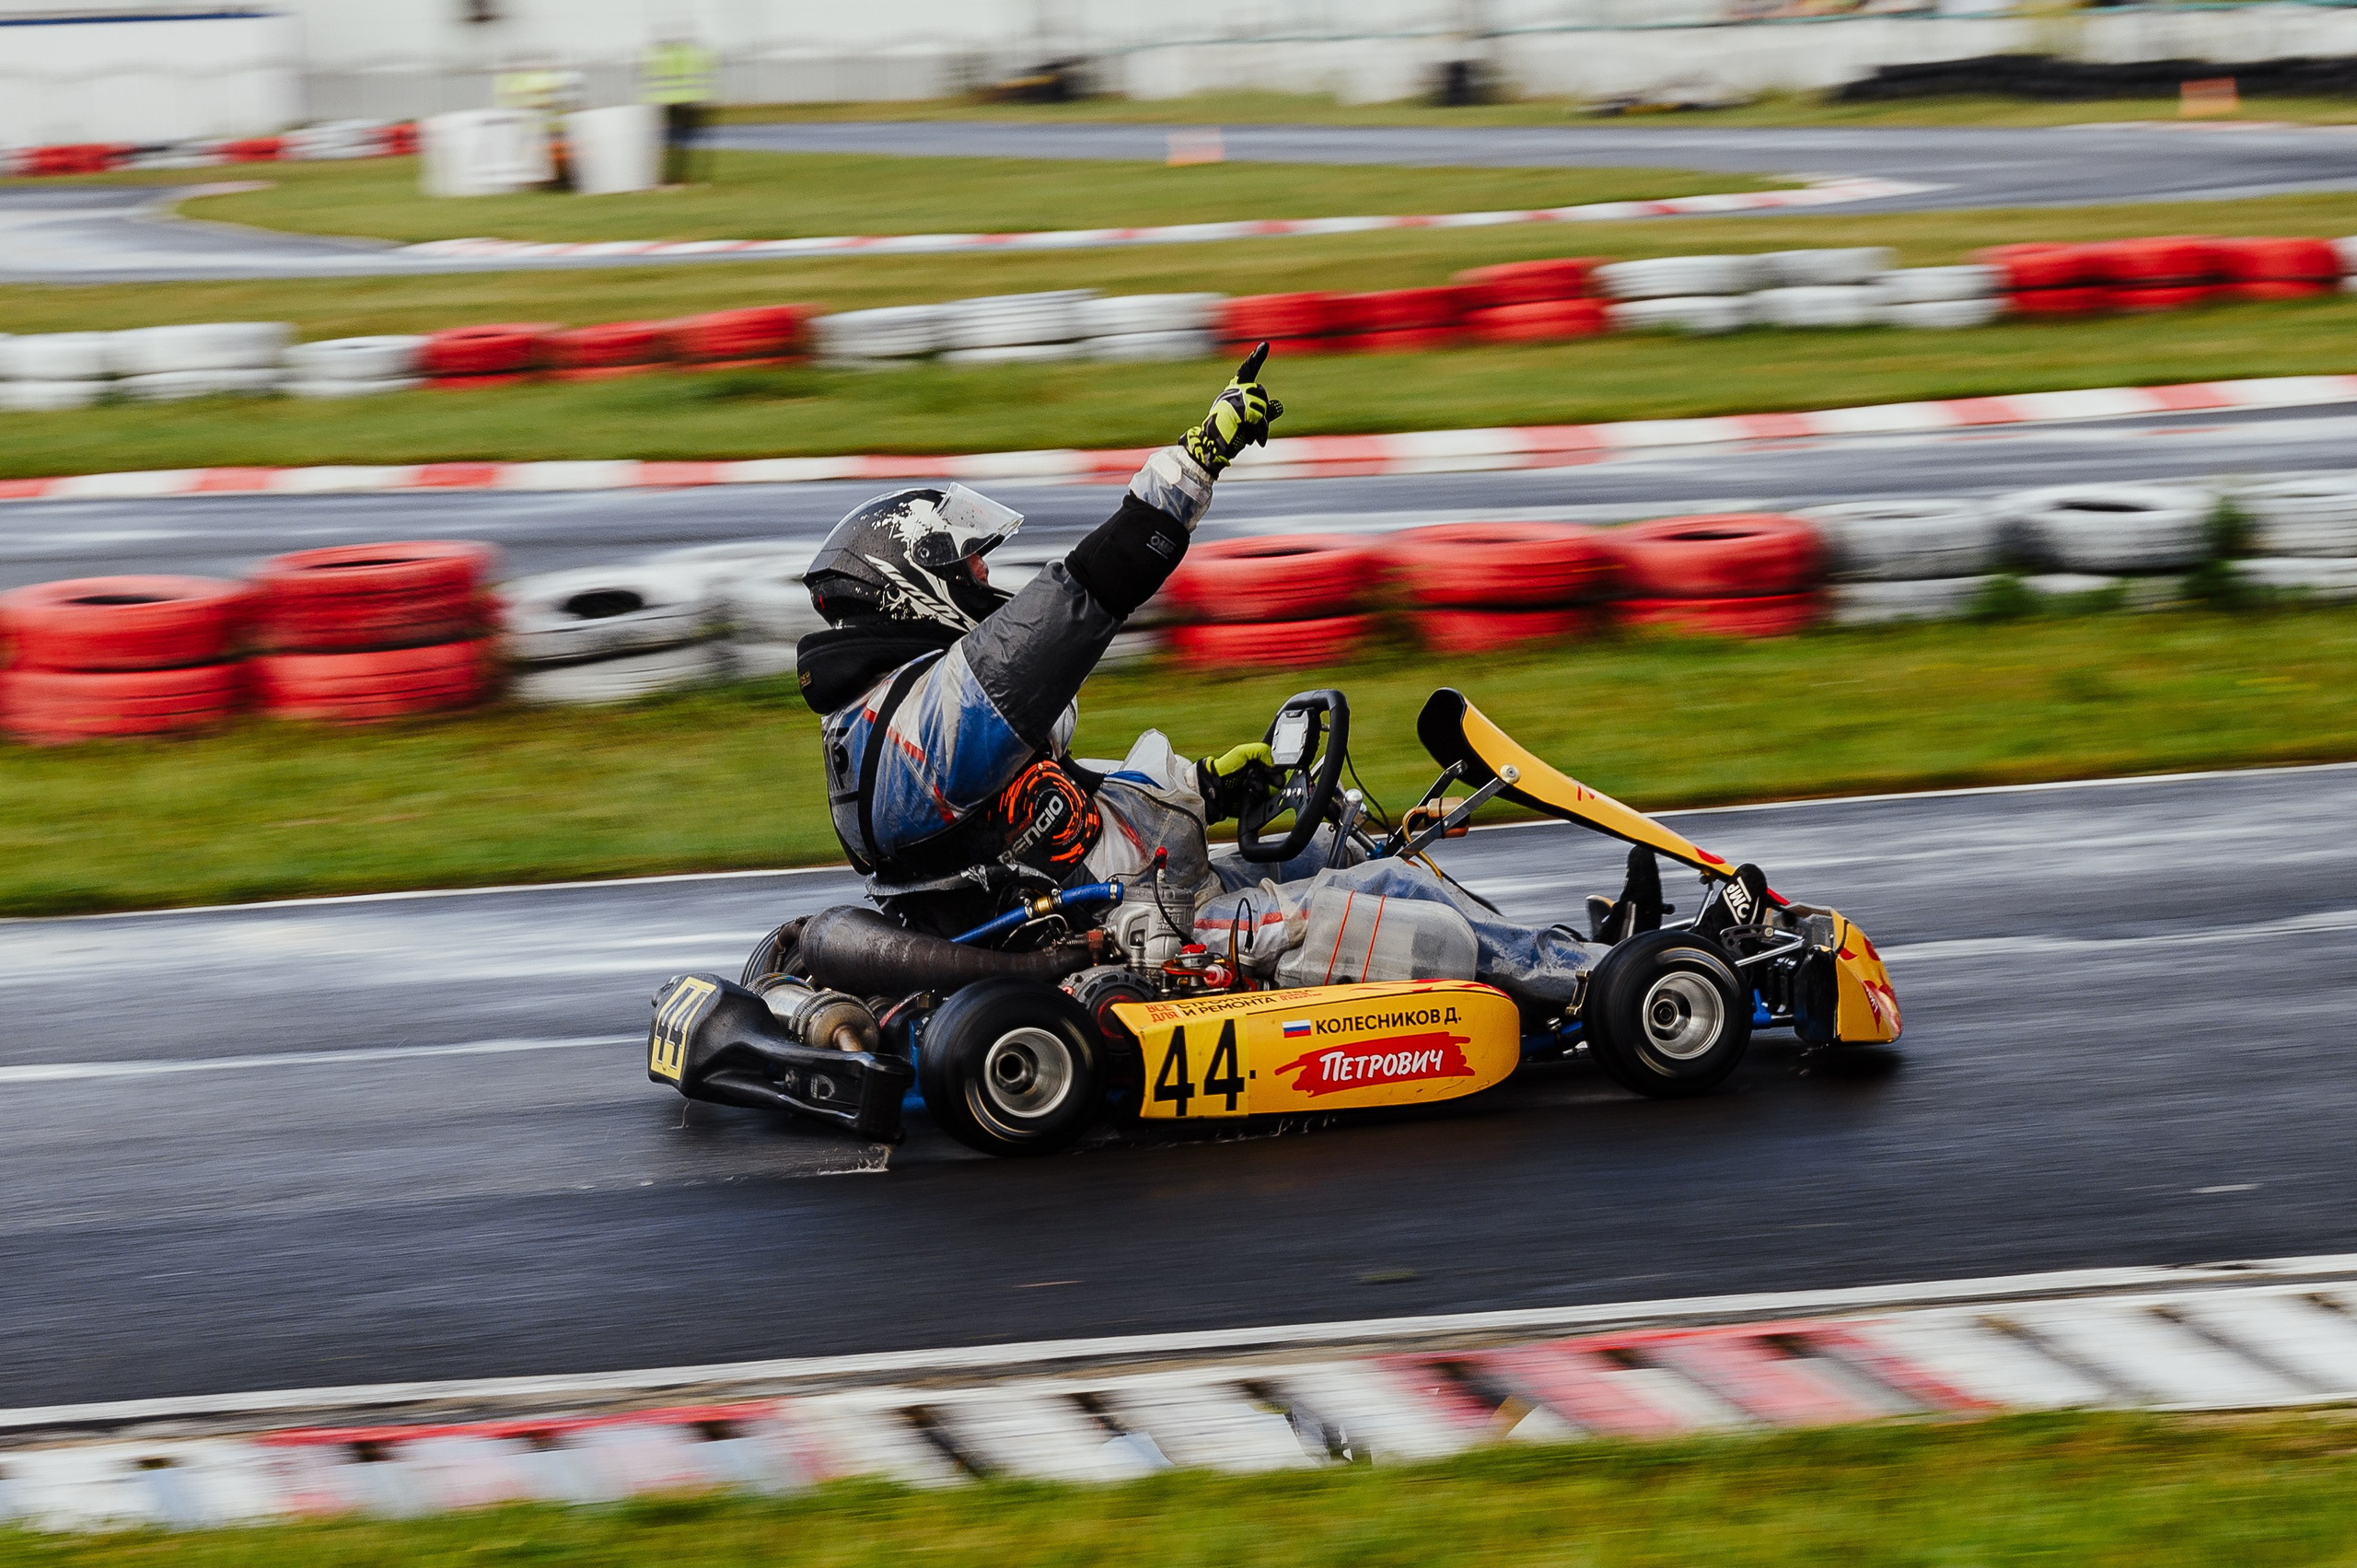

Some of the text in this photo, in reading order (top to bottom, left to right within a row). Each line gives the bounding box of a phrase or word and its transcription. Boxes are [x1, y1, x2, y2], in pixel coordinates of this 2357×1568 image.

[1144, 1004, 1172, 1013] ВСЕ
[1198, 997, 1277, 1014] РЕМОНТА
[1151, 1012, 1178, 1024] ДЛЯ
[1316, 1006, 1462, 1035] КОЛЕСНИКОВ Д.
[1319, 1048, 1444, 1082] ПЕТРОВИЧ
